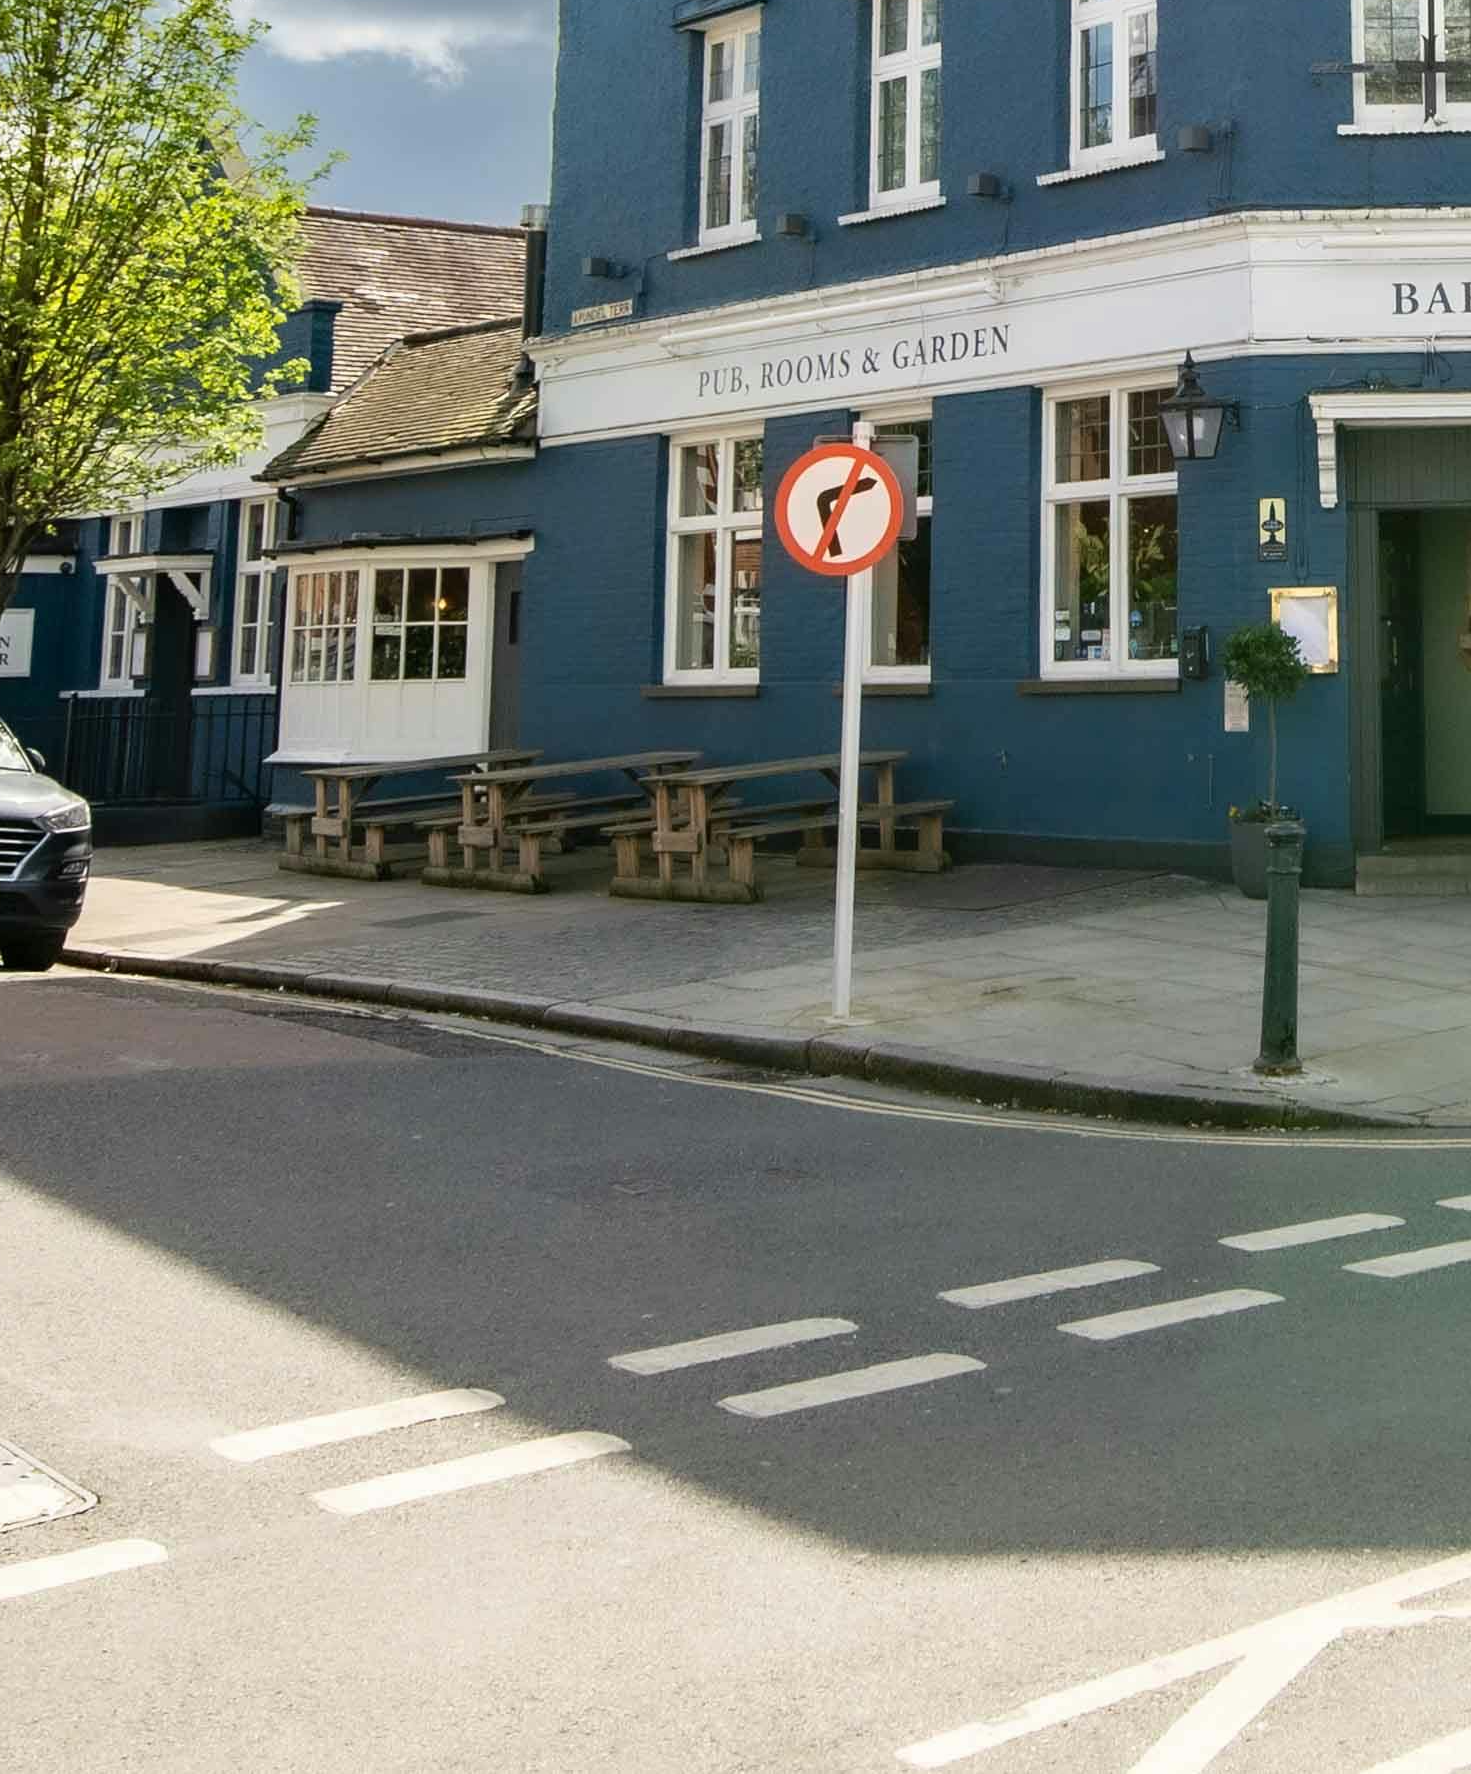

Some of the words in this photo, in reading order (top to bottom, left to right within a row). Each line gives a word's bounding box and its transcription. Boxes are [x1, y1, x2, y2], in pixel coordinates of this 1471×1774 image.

[698, 365, 751, 398] PUB,
[759, 349, 851, 390] ROOMS
[861, 346, 881, 375] &
[892, 324, 1012, 370] GARDEN
